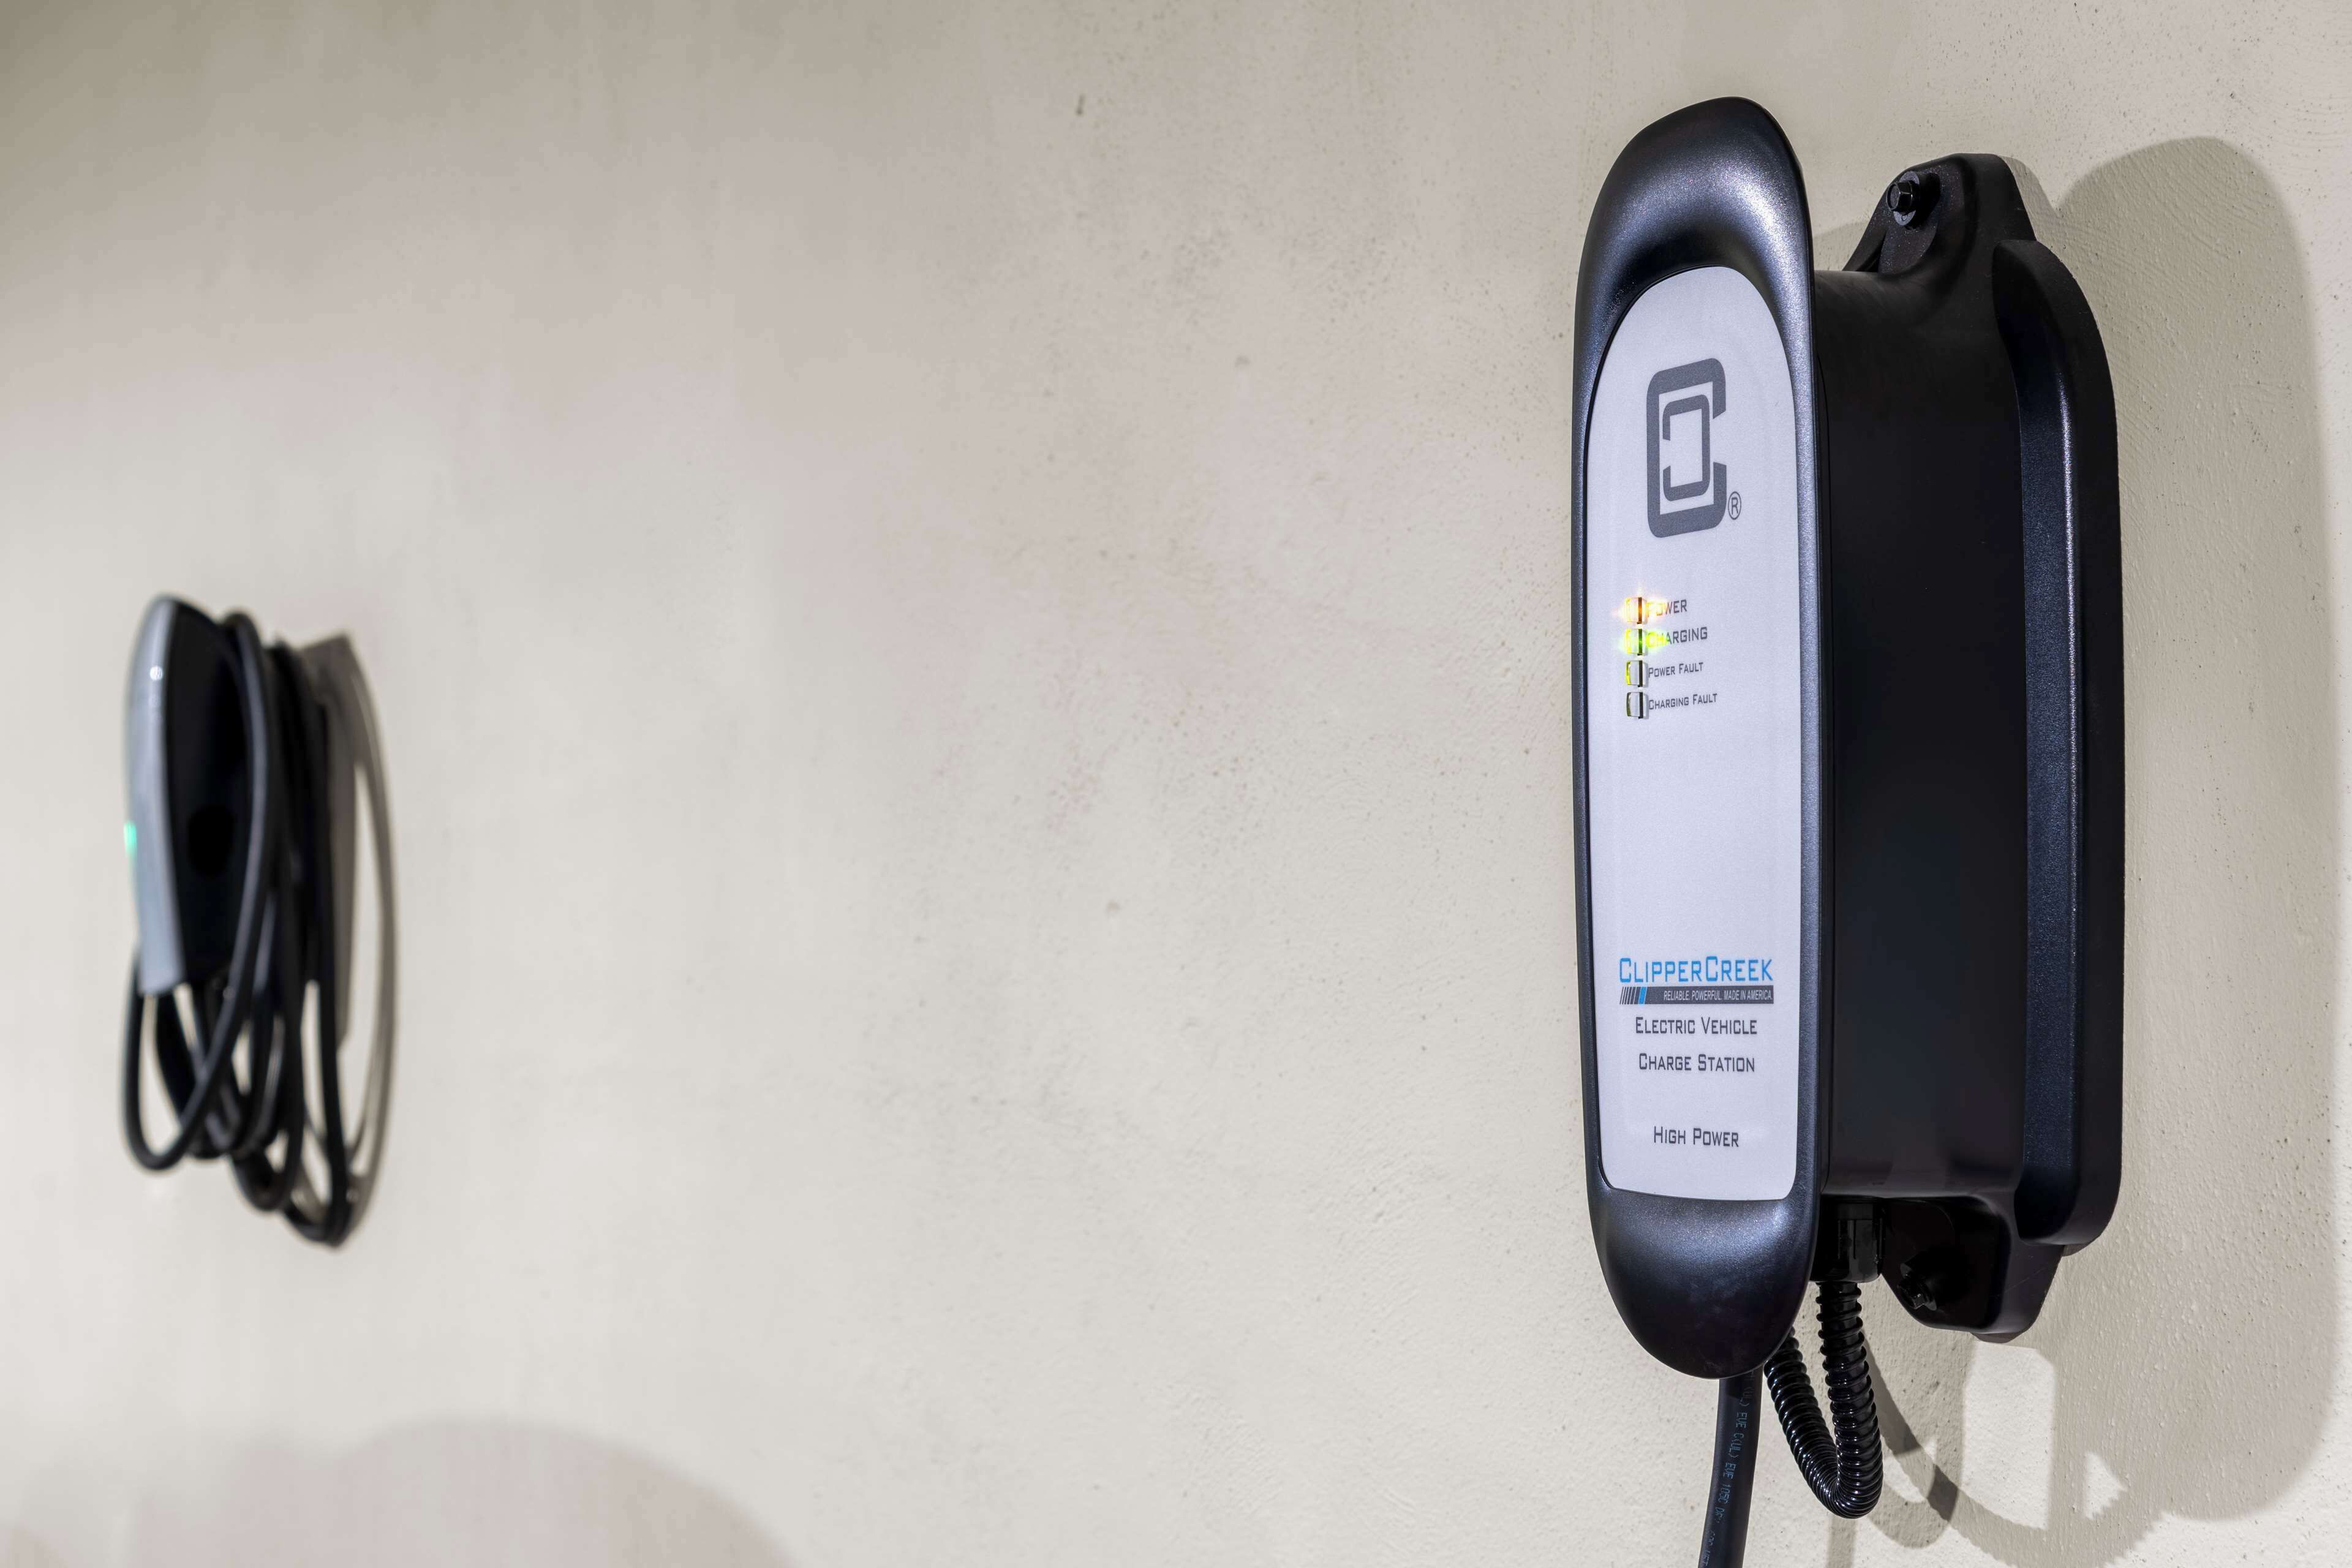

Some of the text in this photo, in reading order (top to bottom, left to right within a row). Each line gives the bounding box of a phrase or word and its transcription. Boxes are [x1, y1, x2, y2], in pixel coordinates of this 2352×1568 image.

[1648, 662, 1703, 677] POWER FAULT
[1649, 693, 1718, 709] CHARGING FAULT
[1619, 956, 1773, 983] CLIPPERCREEK
[1664, 990, 1773, 1001] RELIABLE. POWERFUL. MADE IN AMERICA.
[1635, 1017, 1757, 1035] ELECTRIC VEHICLE
[1639, 1053, 1755, 1072] CHARGE STATION
[1654, 1126, 1740, 1147] HIGH POWER
